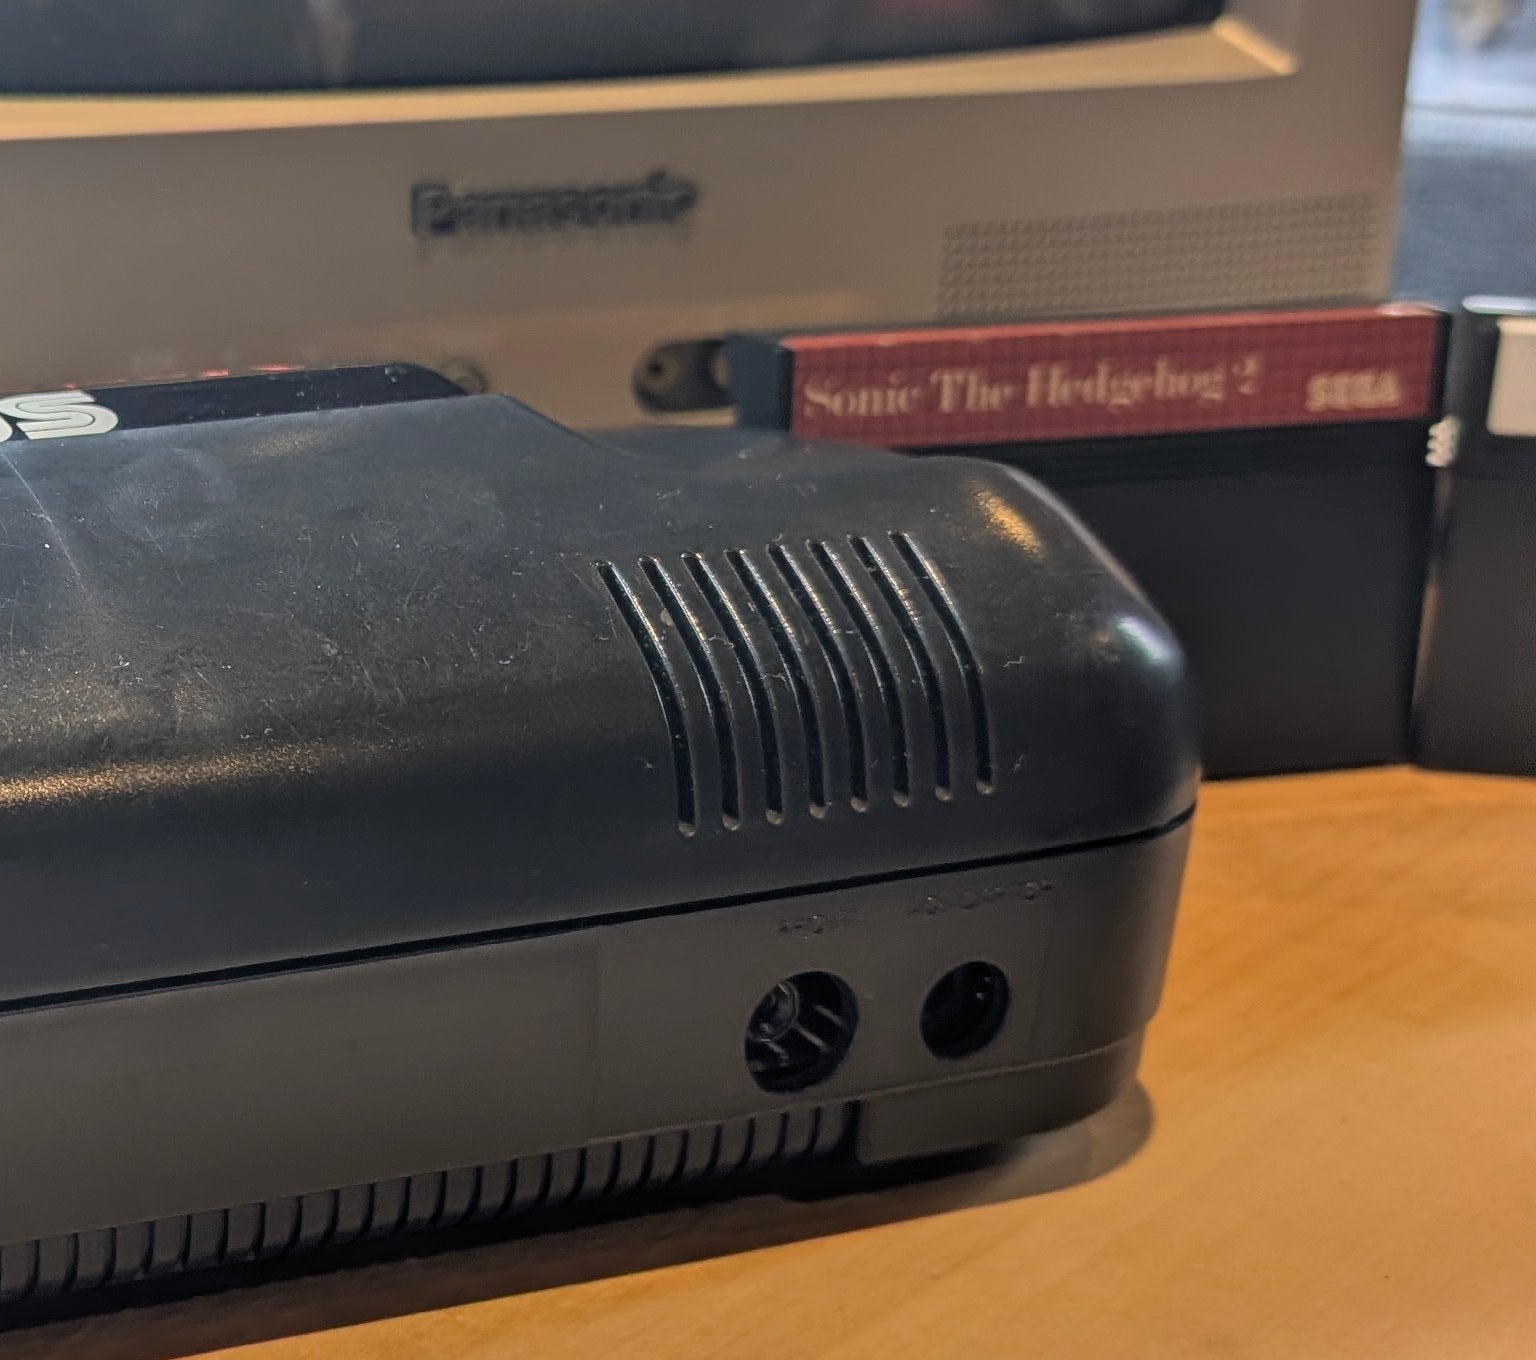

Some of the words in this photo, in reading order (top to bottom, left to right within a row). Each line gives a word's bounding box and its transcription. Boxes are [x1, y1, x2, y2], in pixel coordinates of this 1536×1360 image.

[803, 371, 920, 419] Sonic
[930, 366, 1011, 415] The
[1025, 354, 1226, 408] Hedgehog
